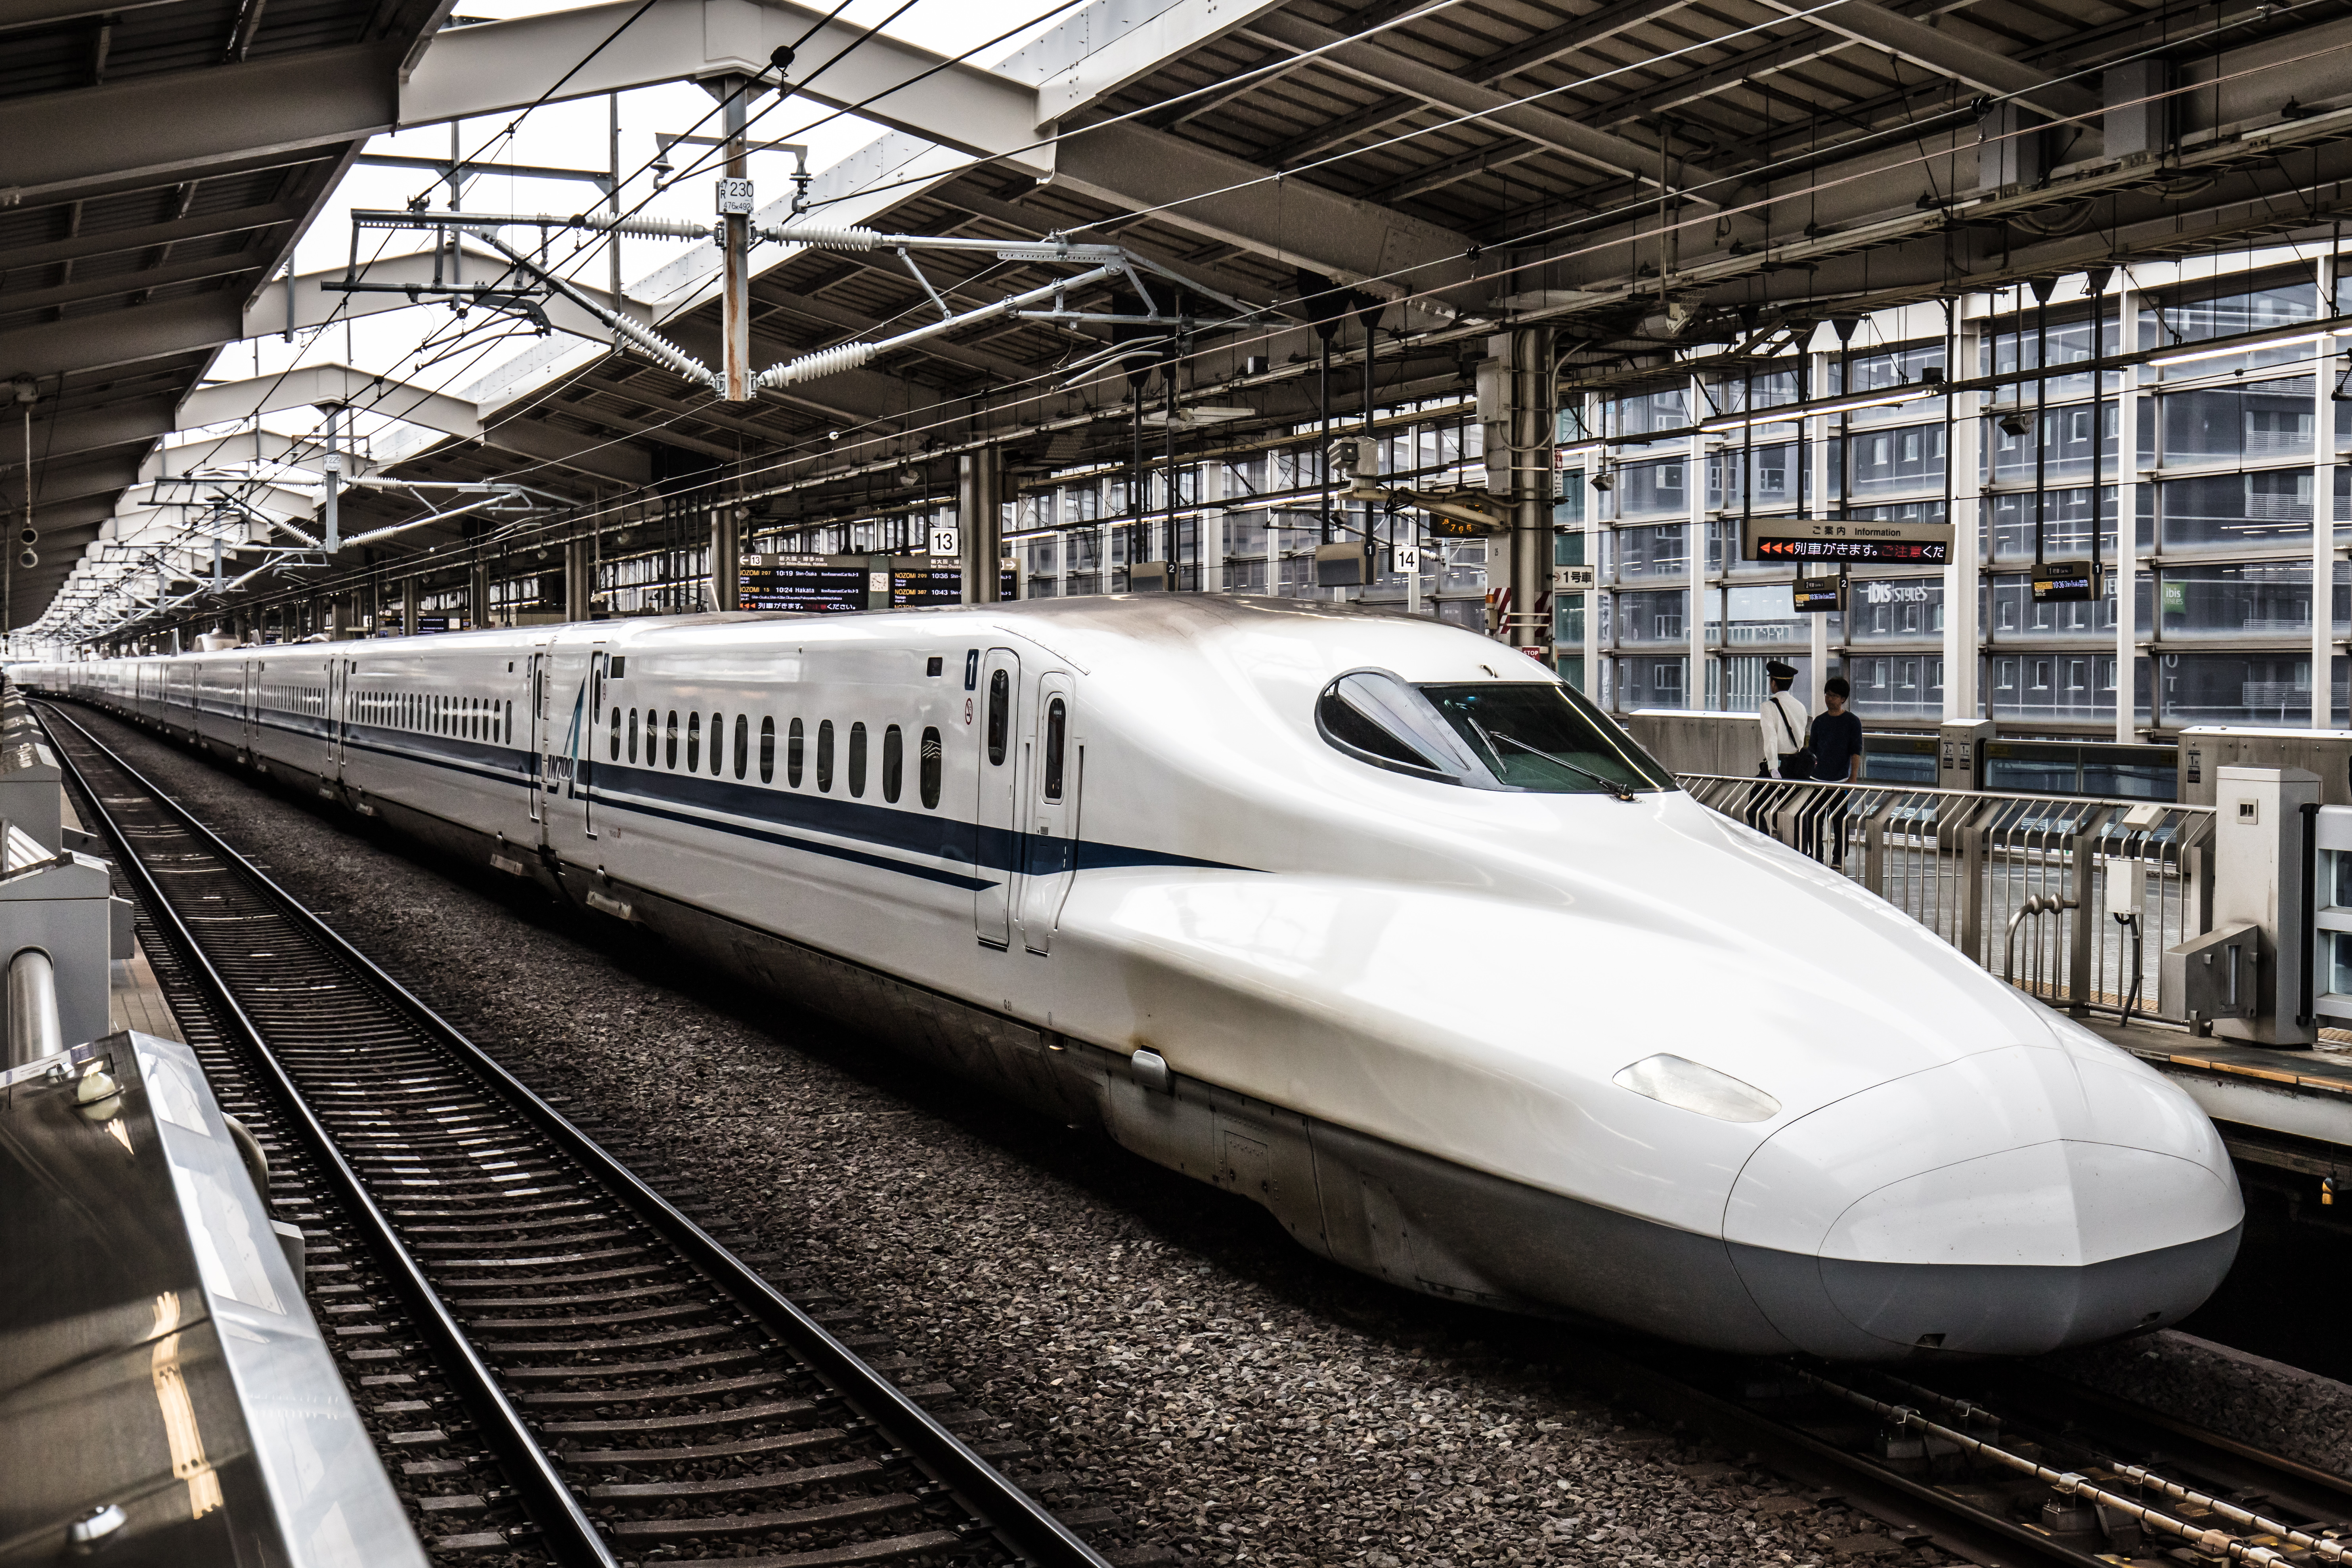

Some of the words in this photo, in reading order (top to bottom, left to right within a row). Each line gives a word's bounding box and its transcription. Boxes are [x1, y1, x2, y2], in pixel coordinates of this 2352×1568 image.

[720, 189, 726, 199] R
[730, 182, 753, 197] 230
[1813, 526, 1845, 535] ご案内
[1855, 528, 1901, 537] Information
[935, 533, 952, 550] 13
[1367, 545, 1372, 555] 1
[1399, 551, 1415, 567] 14
[2095, 565, 2099, 573] 1
[1563, 571, 1592, 583] 1号車
[1868, 581, 1892, 603] ibis
[2166, 587, 2181, 598] ibis
[969, 654, 975, 685] 1
[1945, 744, 1949, 753] 2
[1962, 746, 1965, 754] 1
[2190, 755, 2193, 765] 1
